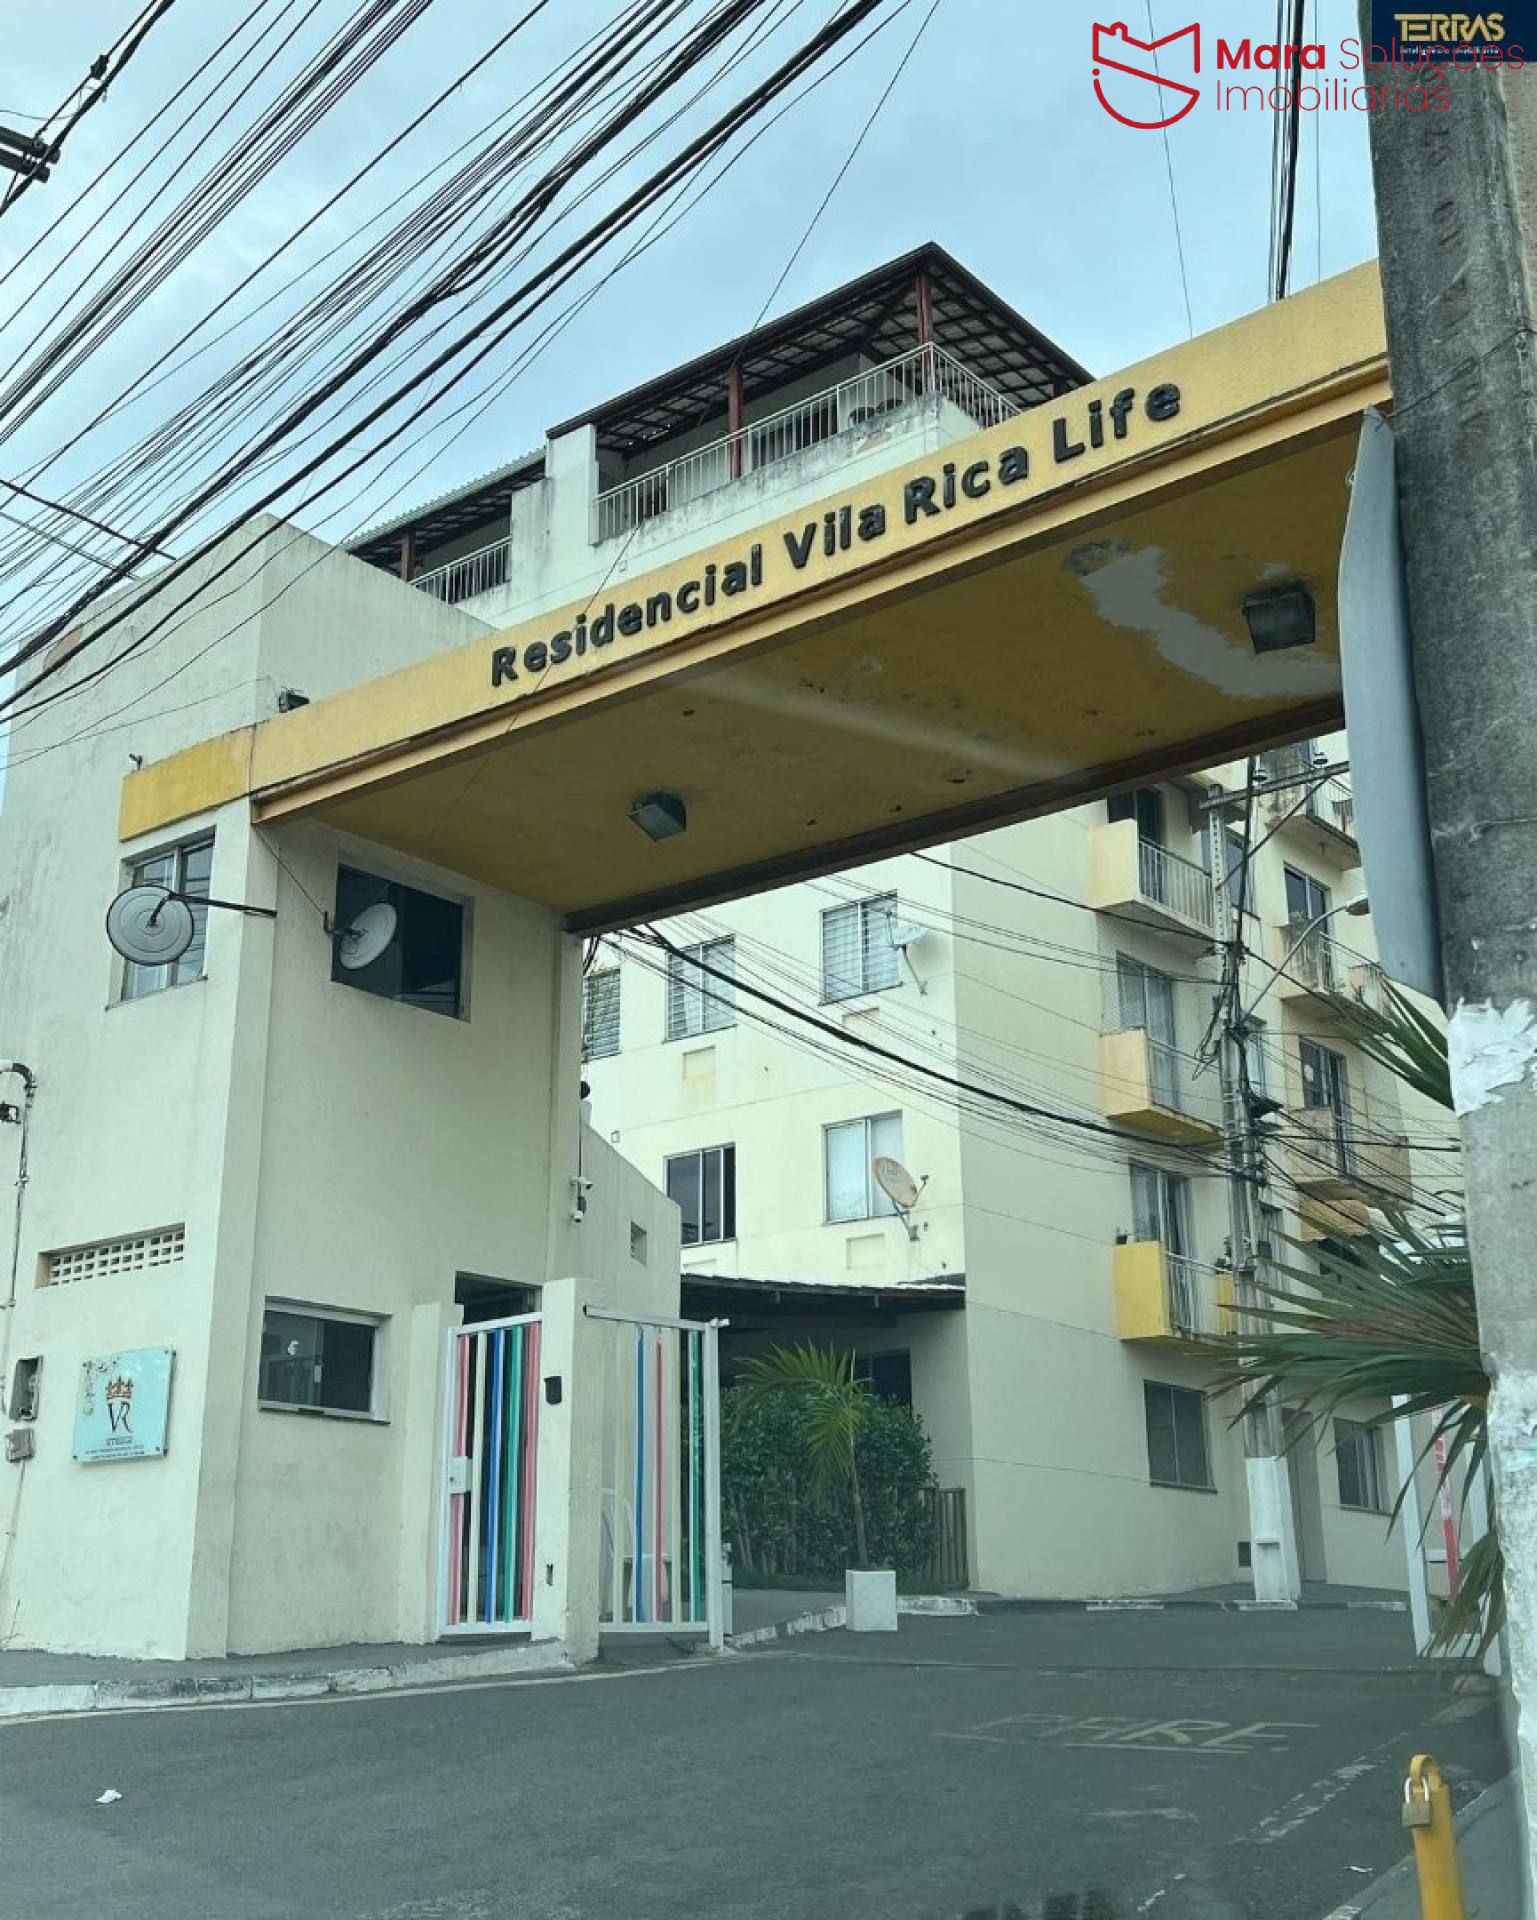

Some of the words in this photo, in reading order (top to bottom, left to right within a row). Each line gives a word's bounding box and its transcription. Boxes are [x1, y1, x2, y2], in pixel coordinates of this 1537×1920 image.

[491, 543, 763, 687] Residencial
[783, 504, 887, 570] Vila
[903, 445, 1028, 526] Rica
[1052, 383, 1182, 463] Life
